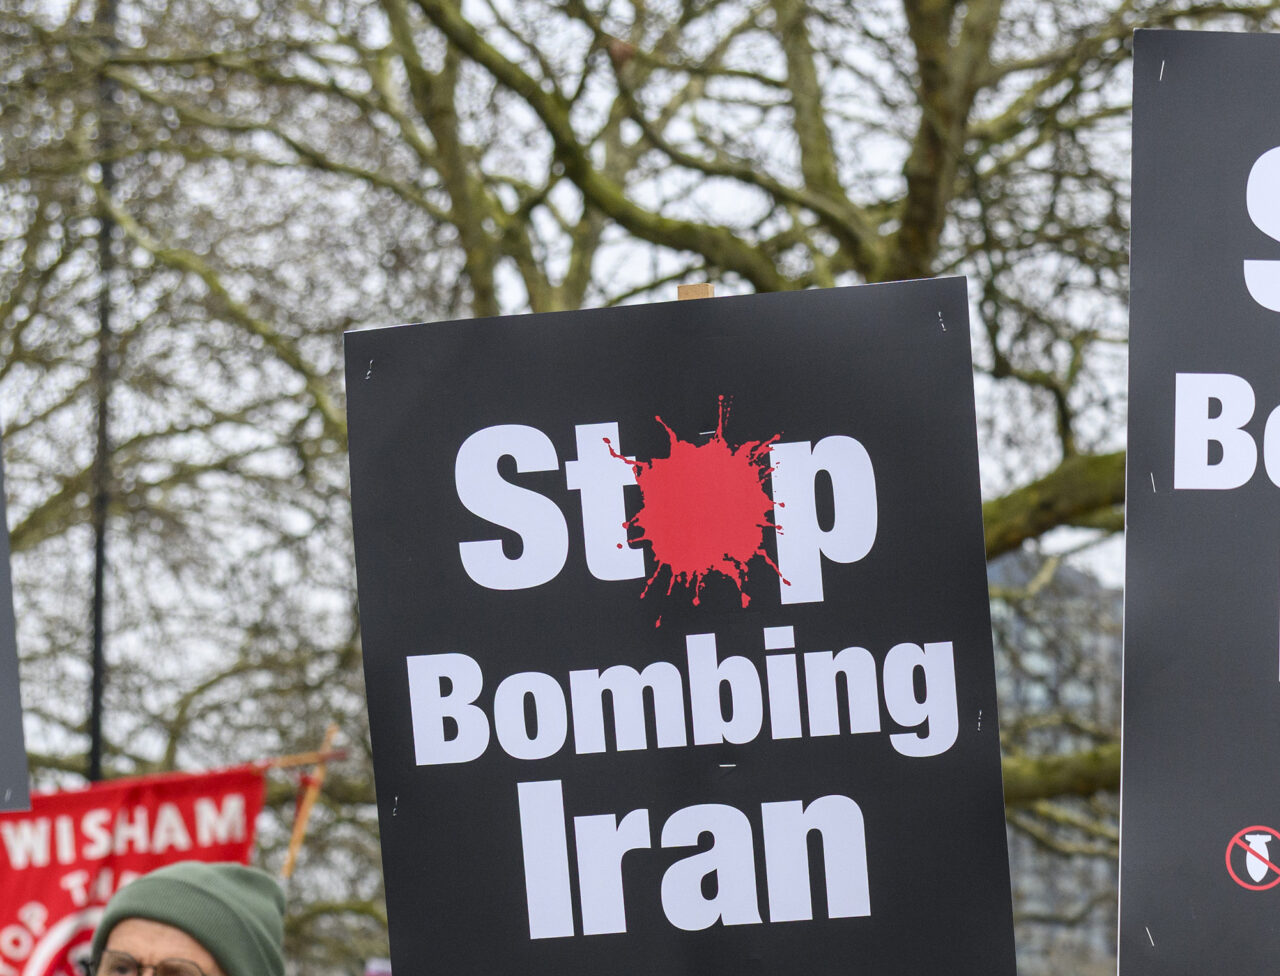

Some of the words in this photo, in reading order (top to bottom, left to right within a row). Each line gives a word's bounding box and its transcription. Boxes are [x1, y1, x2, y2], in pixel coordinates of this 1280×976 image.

[455, 421, 878, 605] Stp
[406, 625, 959, 766] Bombing
[517, 779, 872, 940] Iran
